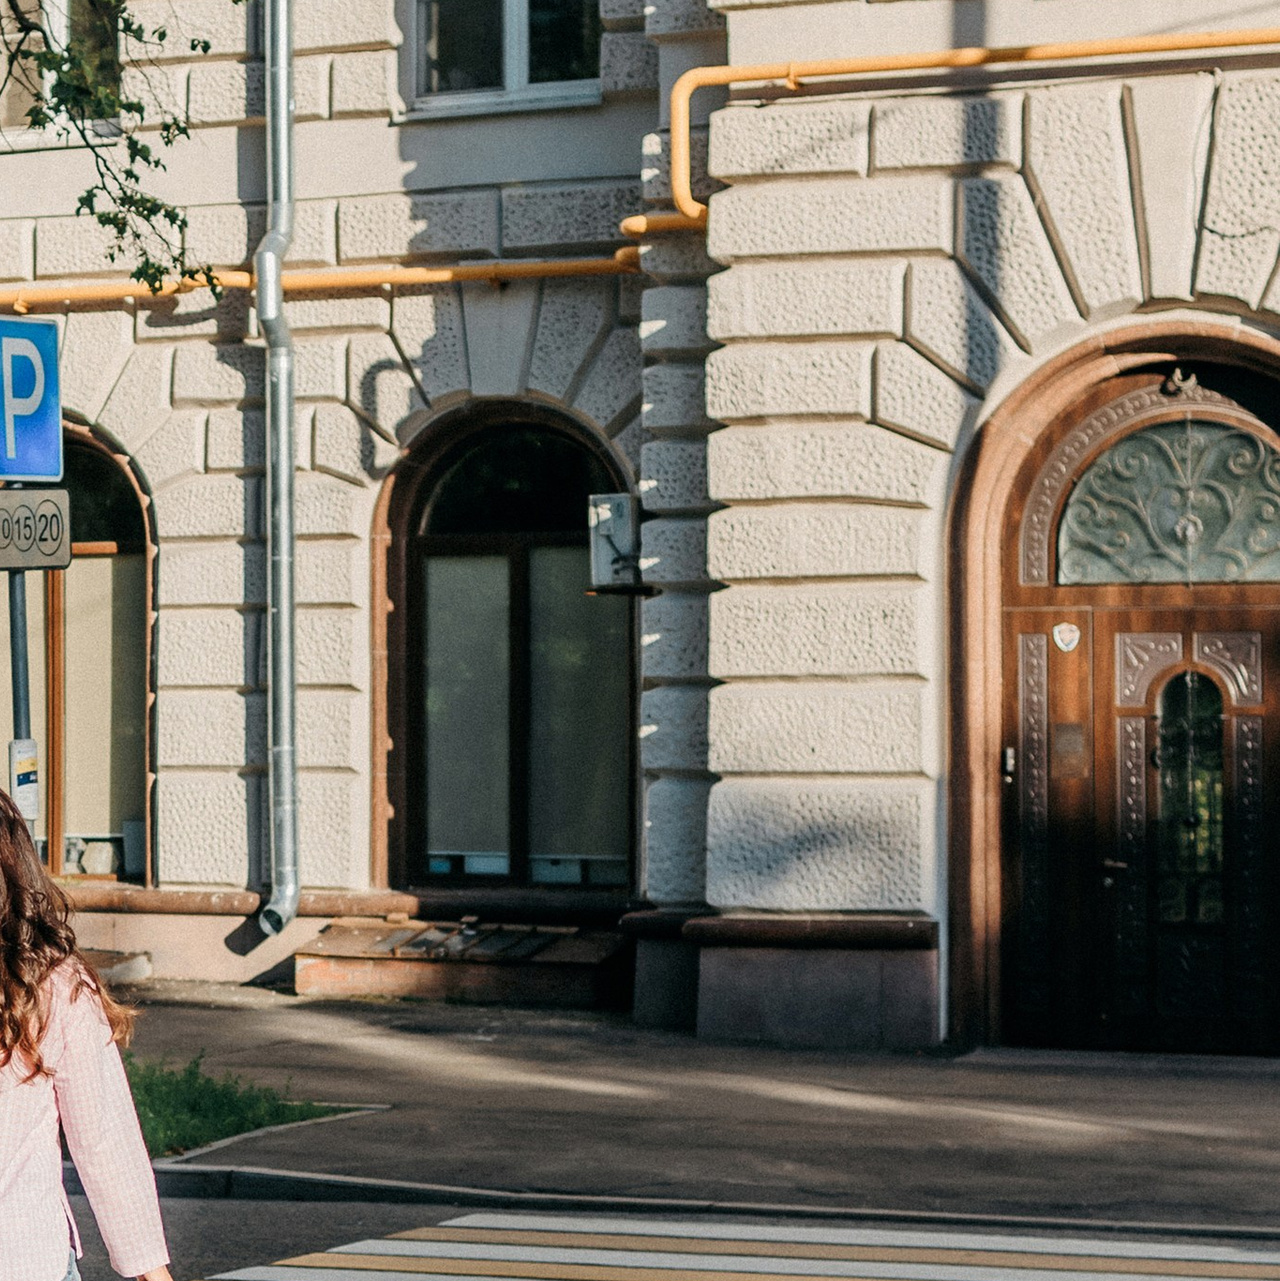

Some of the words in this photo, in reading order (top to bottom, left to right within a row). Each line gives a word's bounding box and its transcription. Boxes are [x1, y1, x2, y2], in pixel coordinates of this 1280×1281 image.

[1, 336, 46, 460] P
[14, 516, 33, 541] 15
[38, 513, 60, 542] 20
